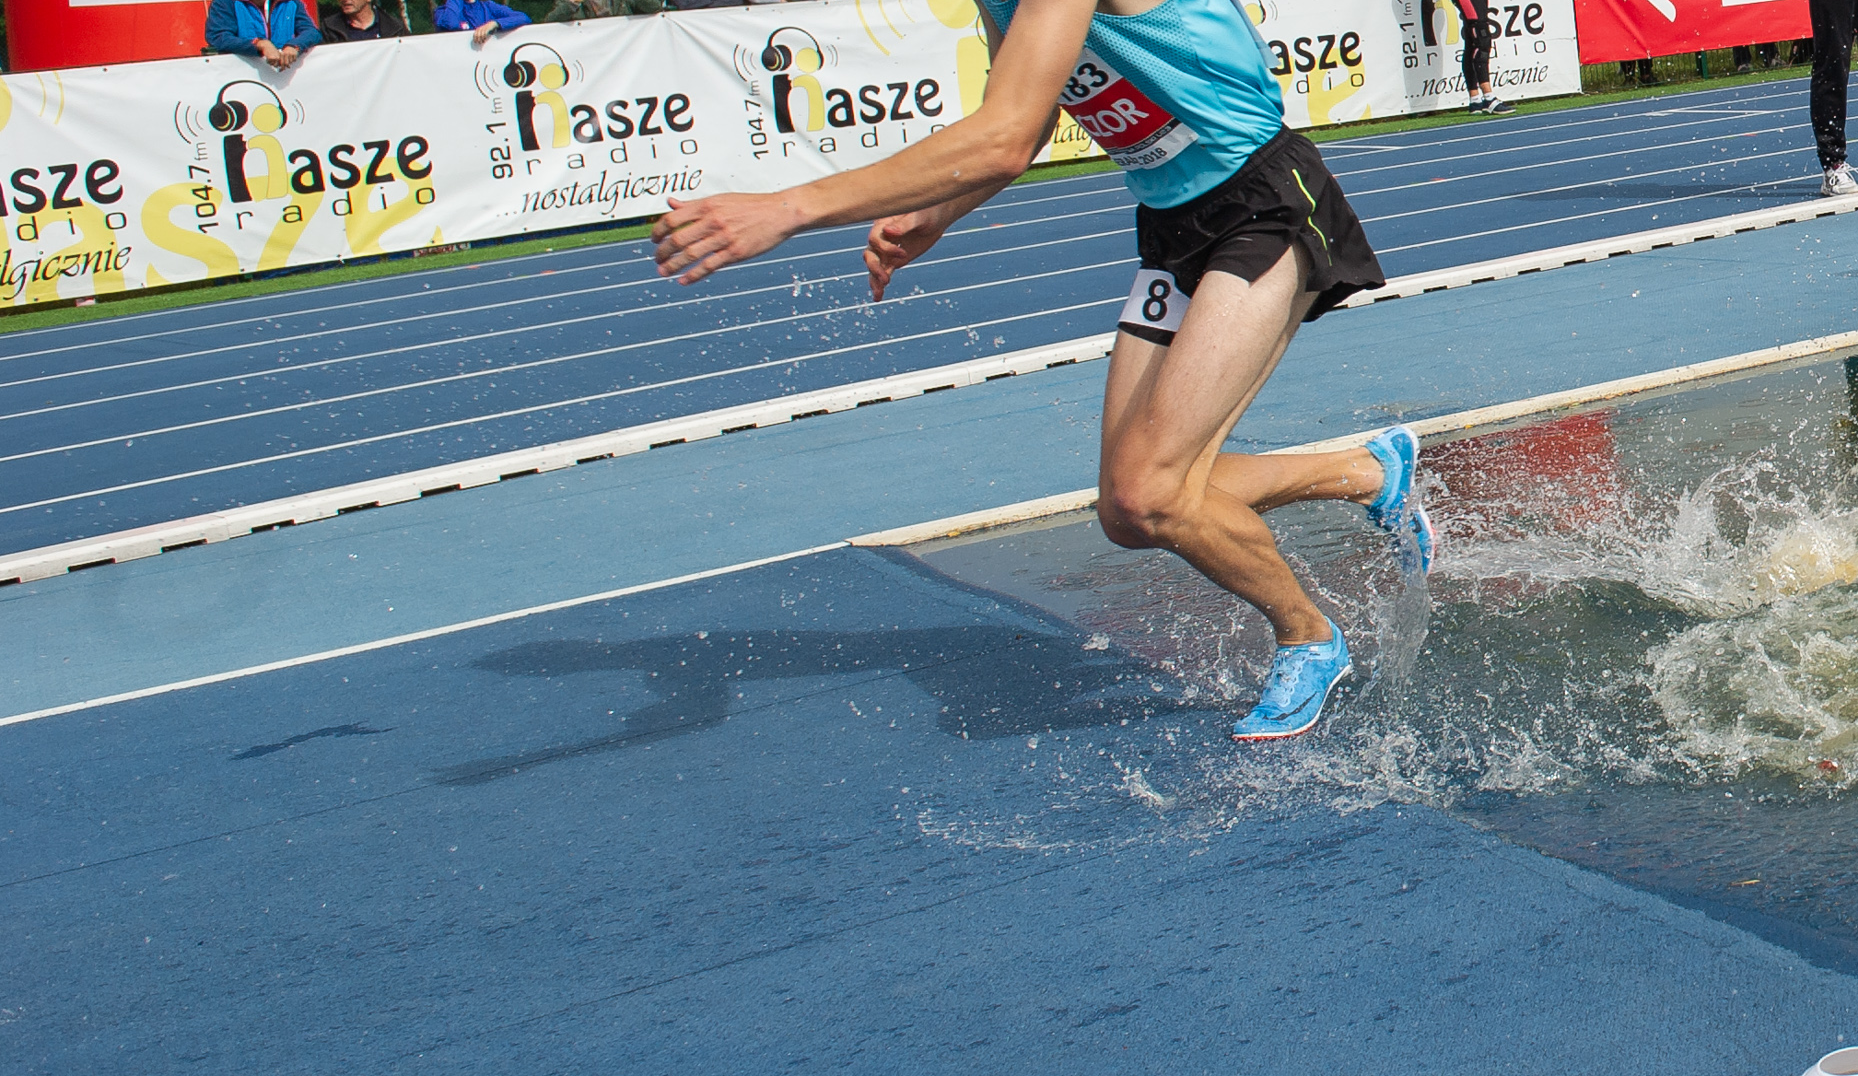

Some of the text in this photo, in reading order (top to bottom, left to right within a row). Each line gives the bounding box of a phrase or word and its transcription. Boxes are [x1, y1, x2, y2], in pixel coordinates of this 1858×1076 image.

[1268, 31, 1362, 76] asze
[1399, 2, 1418, 69] 92.1 fm
[773, 74, 943, 134] nasze
[1296, 71, 1365, 94] dio
[485, 97, 514, 179] 92.1 fm
[515, 90, 694, 151] nasze
[744, 80, 769, 160] 104.7 fm
[1075, 98, 1150, 137] CZOR
[223, 134, 433, 203] nasze
[526, 138, 698, 175] radio
[1138, 147, 1168, 165] 2018
[0, 159, 124, 217] sze
[188, 141, 219, 234] 104.7 fm
[235, 186, 436, 230] radio
[16, 212, 127, 241] dio
[0, 241, 132, 301] lgicznie
[1142, 278, 1171, 322] 8
